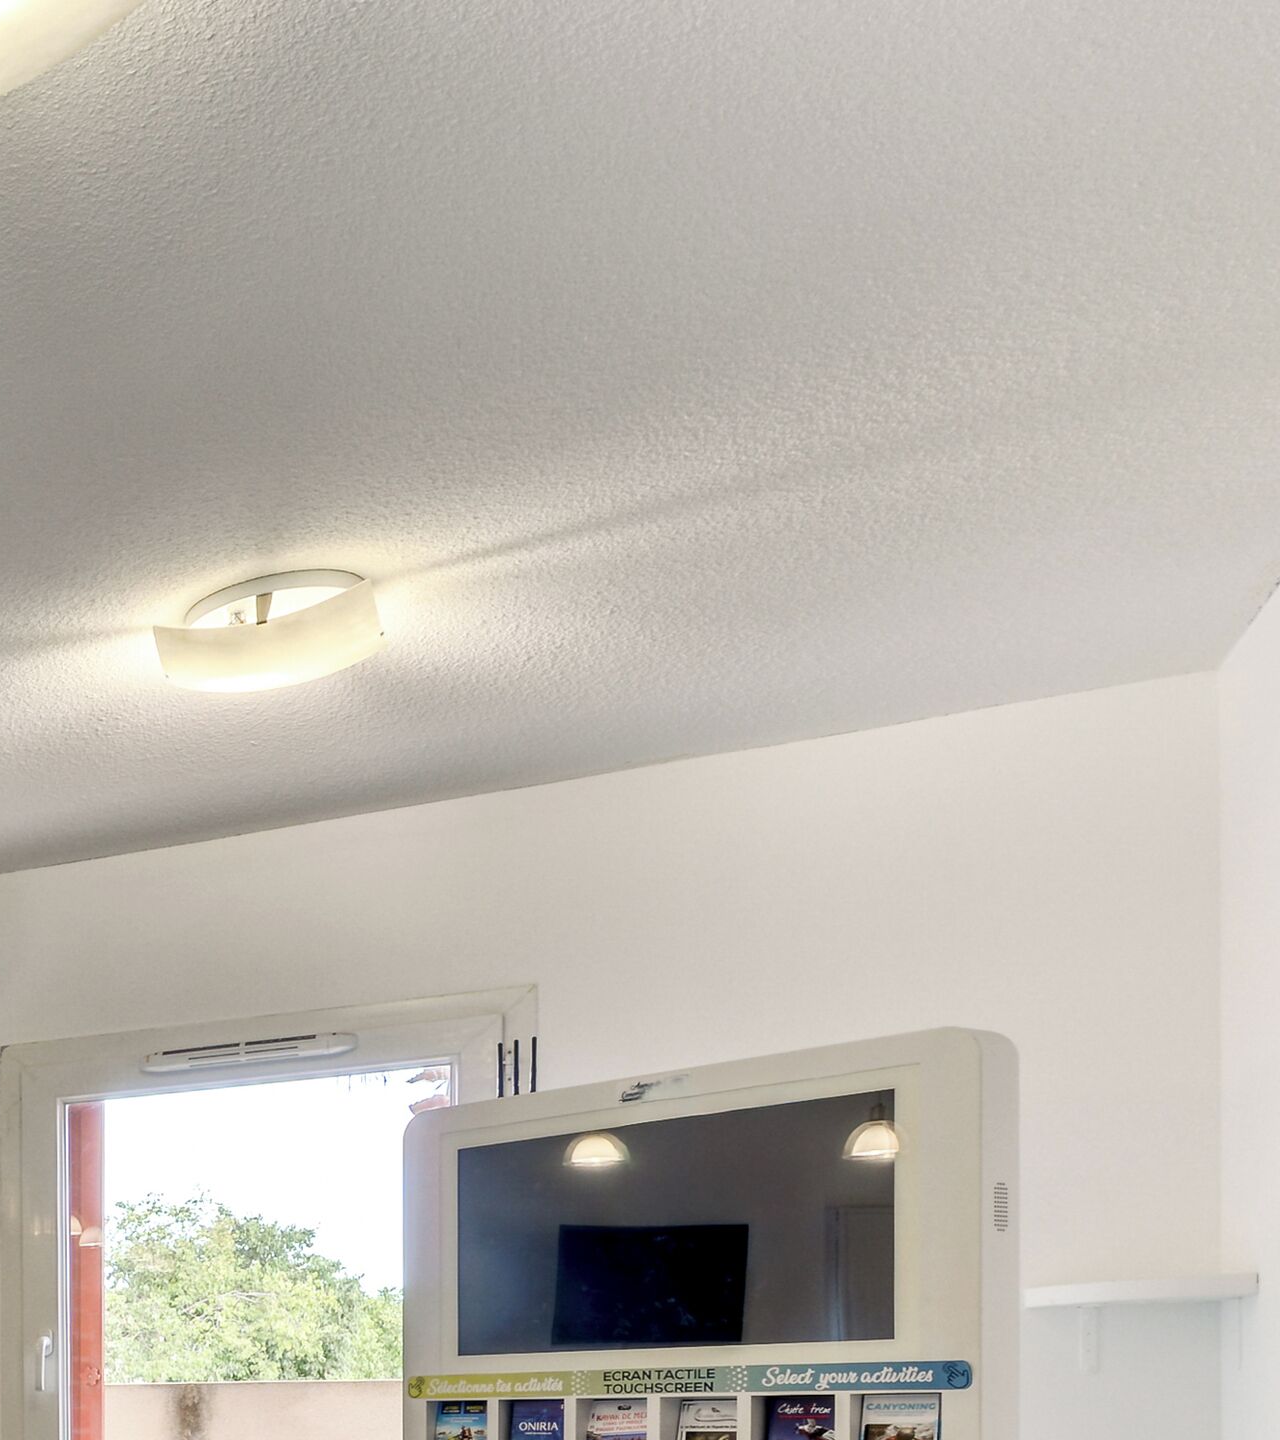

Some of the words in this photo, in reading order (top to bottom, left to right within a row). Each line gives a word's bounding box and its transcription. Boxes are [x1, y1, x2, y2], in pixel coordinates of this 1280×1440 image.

[604, 1370, 652, 1382] ECRAN
[655, 1368, 715, 1380] TACTILE
[762, 1367, 813, 1387] Select
[815, 1370, 857, 1391] your
[860, 1364, 933, 1384] activities
[426, 1379, 493, 1396] Sélectionne
[495, 1379, 512, 1393] tes
[514, 1377, 563, 1394] activités
[604, 1381, 714, 1395] TOUCHSCREEN
[865, 1402, 937, 1411] CANYONING
[518, 1421, 559, 1432] ONIRIA
